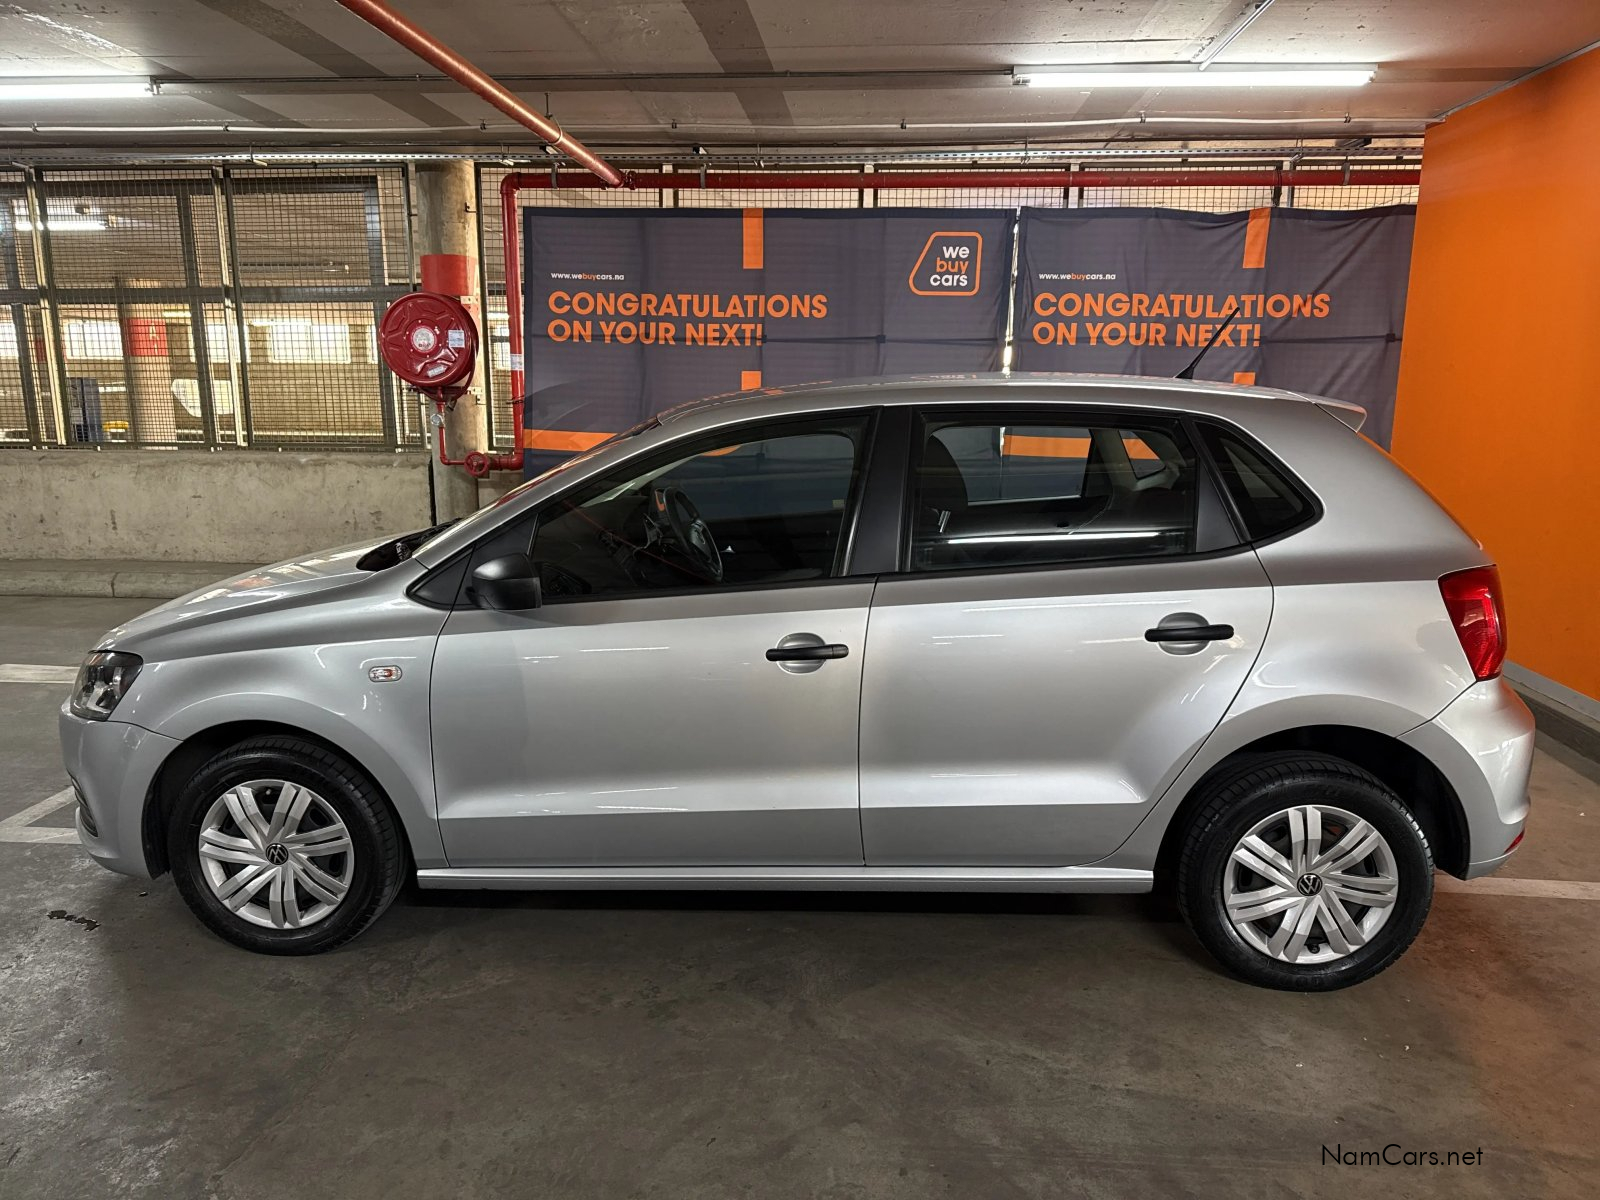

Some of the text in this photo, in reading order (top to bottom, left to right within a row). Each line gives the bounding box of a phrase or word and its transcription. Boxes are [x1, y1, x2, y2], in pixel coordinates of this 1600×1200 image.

[942, 245, 970, 259] we
[936, 256, 969, 274] buy
[550, 272, 625, 281] www.webuycars.na
[929, 274, 968, 287] cars
[1038, 272, 1116, 281] www.webuycars.na
[548, 290, 828, 319] CONGRATULATIONS
[1033, 292, 1331, 318] CONGRATULATIONS
[547, 318, 763, 347] ON YOUR NEXT!
[1032, 321, 1261, 348] ON YOUR NEXT!
